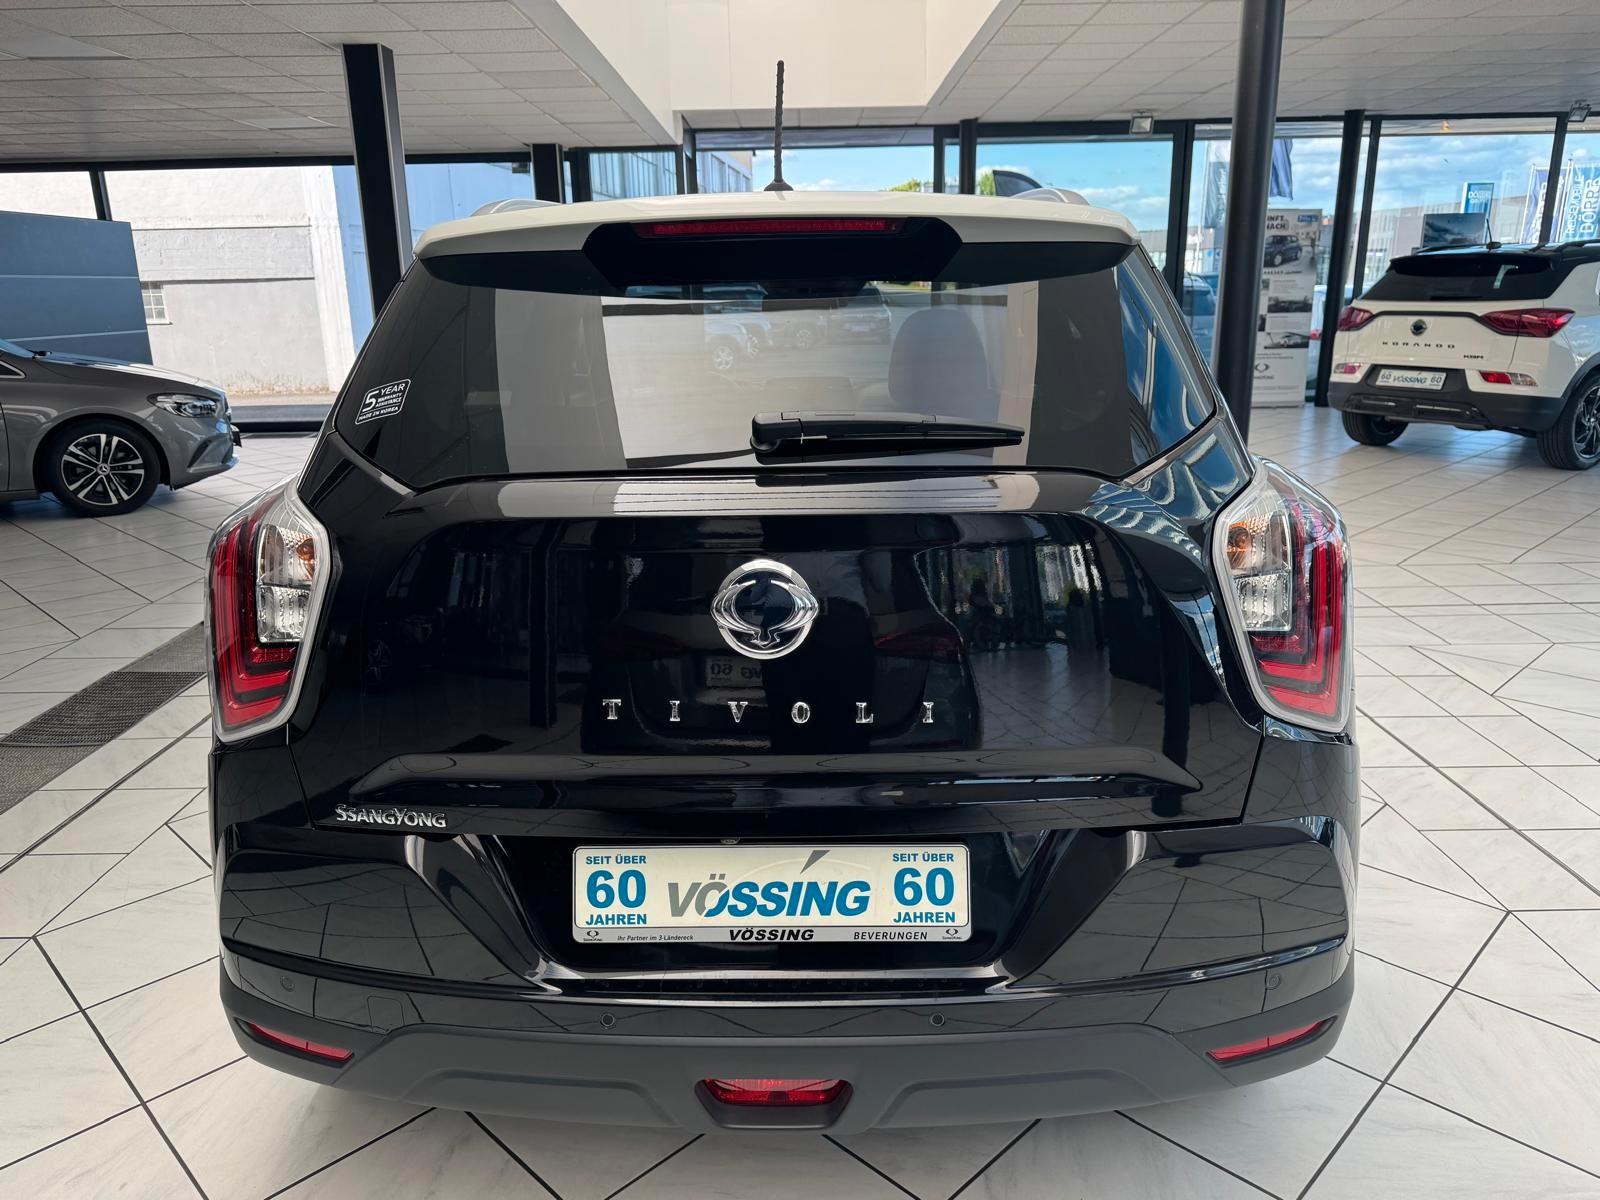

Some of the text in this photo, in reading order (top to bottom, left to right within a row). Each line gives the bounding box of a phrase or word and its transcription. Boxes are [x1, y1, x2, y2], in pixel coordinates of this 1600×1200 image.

[362, 383, 406, 412] 5 YEAR
[358, 412, 373, 421] MADE
[380, 406, 399, 415] KOREA
[602, 698, 936, 724] TIVOLI
[586, 854, 647, 865] SEIT ÜBER
[892, 851, 954, 862] SEIT ÜBER
[586, 869, 647, 909] 60
[893, 867, 955, 906] 60
[667, 873, 871, 918] VÖSSING
[585, 913, 647, 926] JAHREN
[893, 911, 956, 923] JAHREN
[728, 928, 815, 941] VÖSSING
[853, 931, 928, 940] BEVERUNGEN
